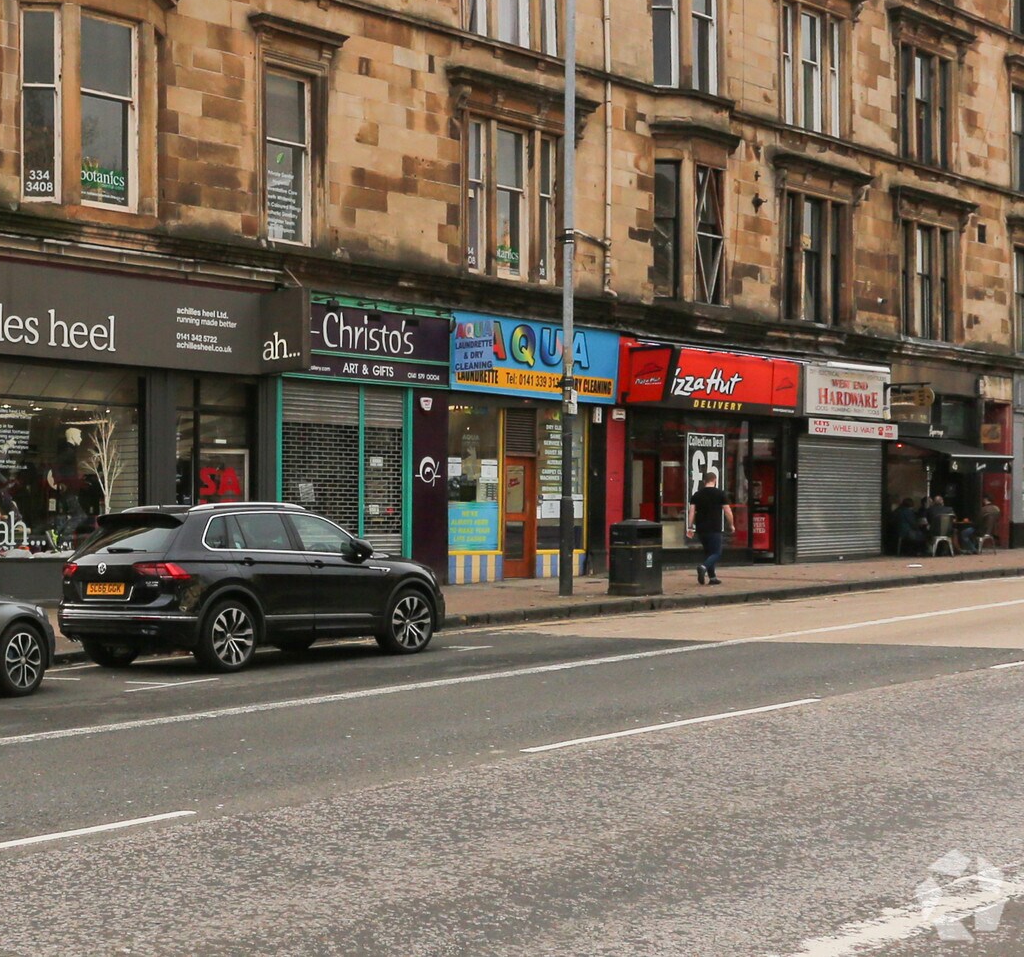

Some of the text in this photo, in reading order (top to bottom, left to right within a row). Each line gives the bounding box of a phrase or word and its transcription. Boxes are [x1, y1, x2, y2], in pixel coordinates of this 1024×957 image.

[29, 170, 50, 180] 334
[26, 182, 53, 192] 3408
[176, 307, 228, 319] achilles heel Ltd.
[176, 317, 200, 326] running
[219, 319, 237, 328] better
[48, 309, 116, 352] heel
[323, 311, 414, 355] Christo's
[456, 321, 492, 339] AQUA
[176, 332, 217, 343] 0141 342 5722
[176, 341, 232, 353] achillesheel.co.uk
[263, 331, 301, 361] ah...
[456, 339, 492, 349] LAUNDRETTE
[470, 351, 484, 359] DRY
[343, 363, 394, 377] ART & GIFTS
[455, 361, 493, 370] CLEANING
[458, 370, 498, 384] LAUNDRETTE
[506, 372, 517, 384] Tel:
[519, 374, 534, 386] 0141
[536, 375, 547, 387] 339
[671, 367, 742, 396] izza Hut
[583, 379, 612, 395] CLEANING
[832, 379, 868, 390] WEST END
[818, 387, 878, 409] HARDWARE
[693, 399, 742, 411] DELIVERY
[832, 425, 851, 433] WHILE
[689, 436, 723, 447] Collection Deal
